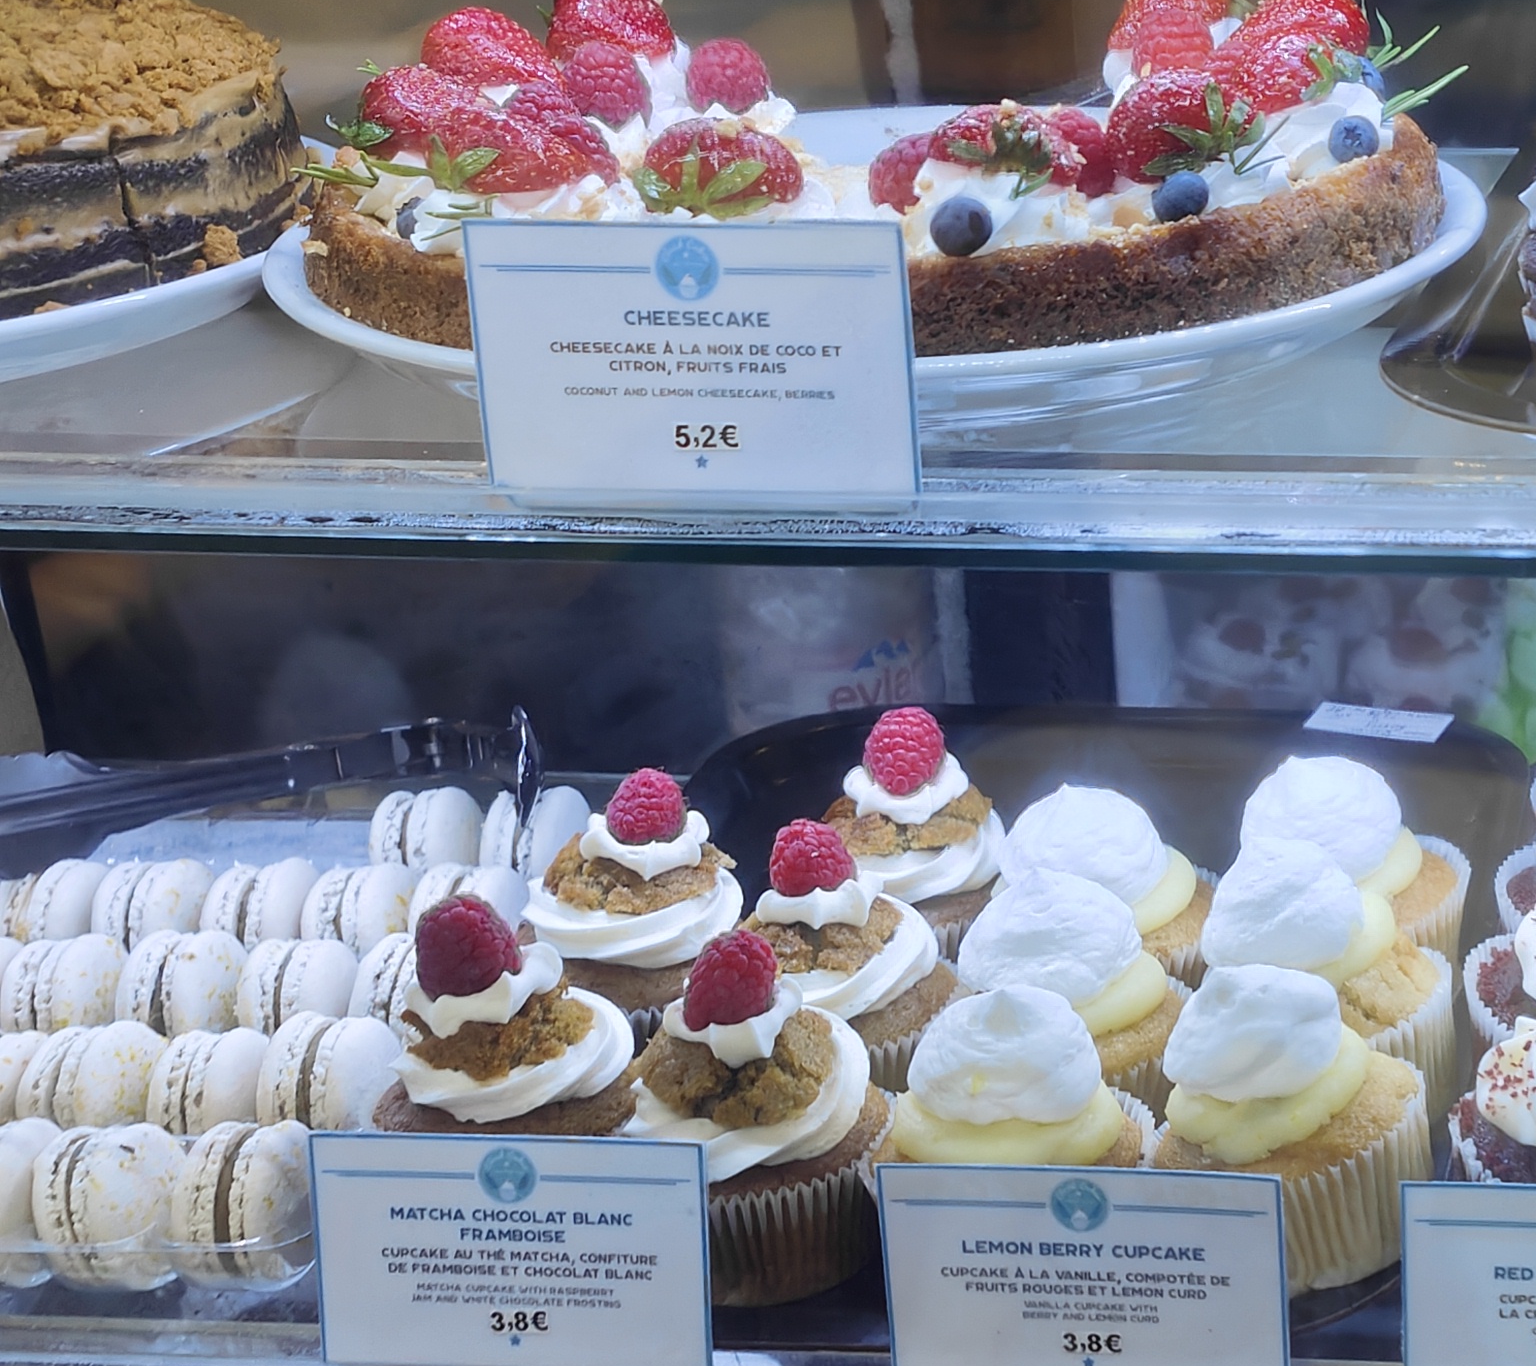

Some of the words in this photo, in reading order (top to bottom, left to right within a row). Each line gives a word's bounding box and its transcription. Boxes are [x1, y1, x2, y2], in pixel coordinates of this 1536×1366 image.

[624, 311, 770, 328] CHEESECAKE
[550, 341, 657, 355] CHEESECAKE
[663, 340, 673, 355] À
[679, 343, 701, 355] LA
[707, 343, 743, 356] NOIX
[749, 344, 770, 356] DE
[776, 345, 817, 357] COCO
[822, 346, 842, 357] ET
[609, 360, 672, 375] CITRON,
[677, 361, 733, 373] FRUITS
[739, 362, 787, 374] FRAIS
[564, 387, 618, 396] COCONUT
[624, 388, 648, 397] AND
[652, 388, 693, 397] LEMON
[698, 389, 781, 401] CHEESECAKE,
[785, 390, 835, 399] BERRIES
[675, 425, 738, 447] 5,2€
[390, 1207, 465, 1221] MATCHA
[472, 1210, 566, 1224] CHOCOLAT
[573, 1212, 632, 1226] BLANC
[460, 1228, 566, 1243] FRAMBOISE
[382, 1248, 448, 1260] CUPCAKE
[454, 1248, 473, 1260] AU
[480, 1248, 506, 1261] THÉ
[510, 1251, 575, 1266] MATCHA,
[579, 1253, 657, 1266] CONFITURE
[962, 1240, 1033, 1256] LEMON
[1039, 1243, 1104, 1258] BERRY
[1112, 1245, 1205, 1261] CUPCAKE
[388, 1263, 407, 1273] DE
[412, 1263, 496, 1276] FRAMBOISE
[501, 1266, 518, 1276] ET
[524, 1267, 599, 1280] CHOCOLAT
[605, 1268, 652, 1280] BLANC
[941, 1267, 1008, 1278] CUPCAKE
[1015, 1266, 1024, 1279] À
[1029, 1269, 1050, 1279] LA
[1057, 1270, 1121, 1285] VANILLE,
[1126, 1271, 1206, 1286] COMPOTÉE
[1210, 1276, 1230, 1286] DE
[1494, 1266, 1534, 1281] RED
[417, 1283, 461, 1292] MATCHA
[466, 1284, 514, 1294] CUPCAKE
[519, 1285, 547, 1294] WITH
[549, 1287, 614, 1296] RASPBERRY
[965, 1282, 1018, 1293] FRUITS
[1023, 1283, 1084, 1295] ROUGES
[1088, 1285, 1106, 1296] ET
[1112, 1286, 1163, 1298] LEMON
[1169, 1288, 1207, 1300] CURD
[462, 1295, 496, 1305] WHITE
[500, 1296, 563, 1306] CHOCOLATE
[566, 1298, 622, 1308] FROSTING
[1024, 1300, 1070, 1309] VANILLA
[1074, 1302, 1126, 1311] CUPCAKE
[1130, 1304, 1158, 1313] WITH
[490, 1311, 548, 1332] 3,8€
[1499, 1309, 1520, 1319] LA
[1063, 1333, 1122, 1353] 3,8€
